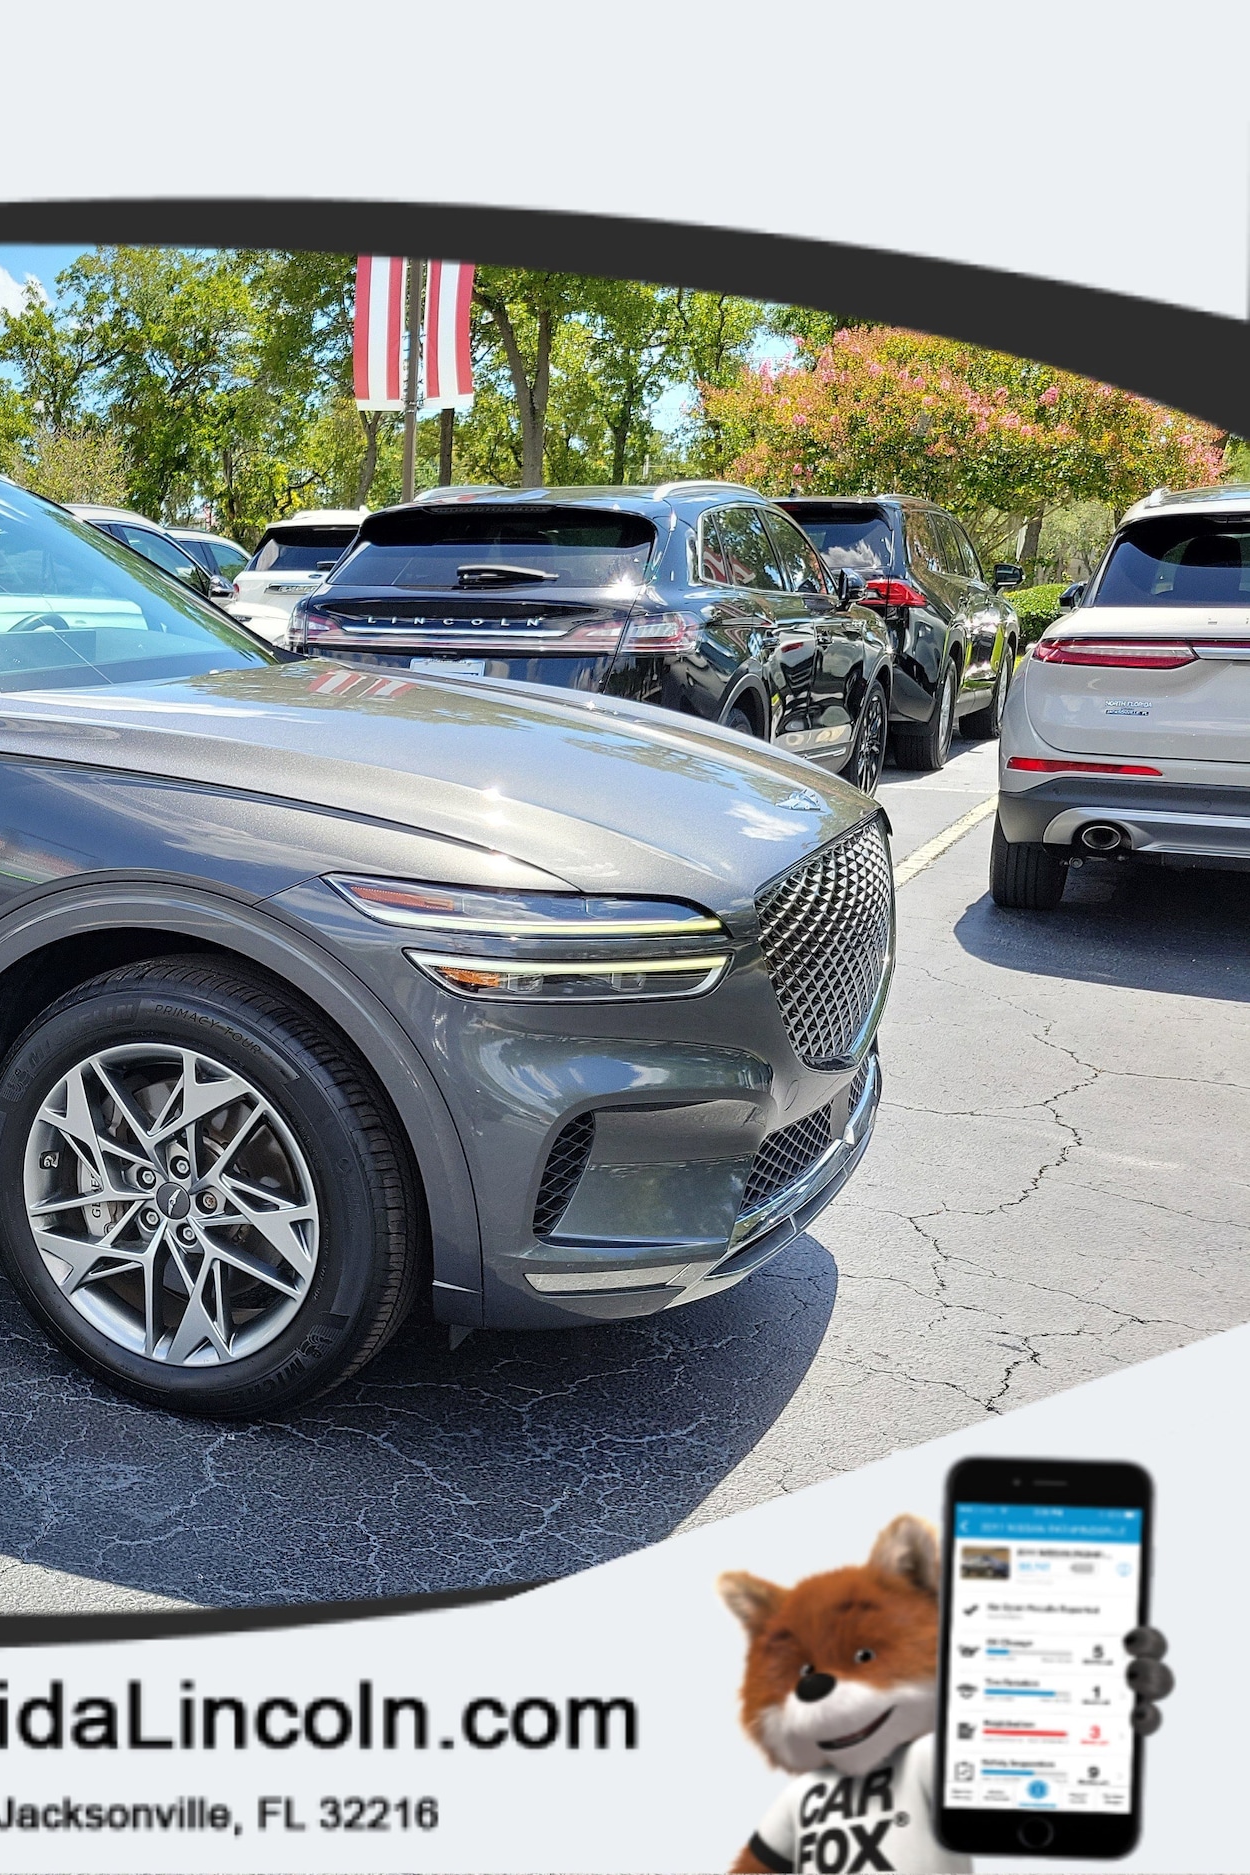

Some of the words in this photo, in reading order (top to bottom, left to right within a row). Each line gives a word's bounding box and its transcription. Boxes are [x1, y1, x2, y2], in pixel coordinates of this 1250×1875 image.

[367, 615, 540, 627] LINCOLN
[154, 1004, 220, 1029] PRIMACY
[224, 1026, 262, 1057] TOUR
